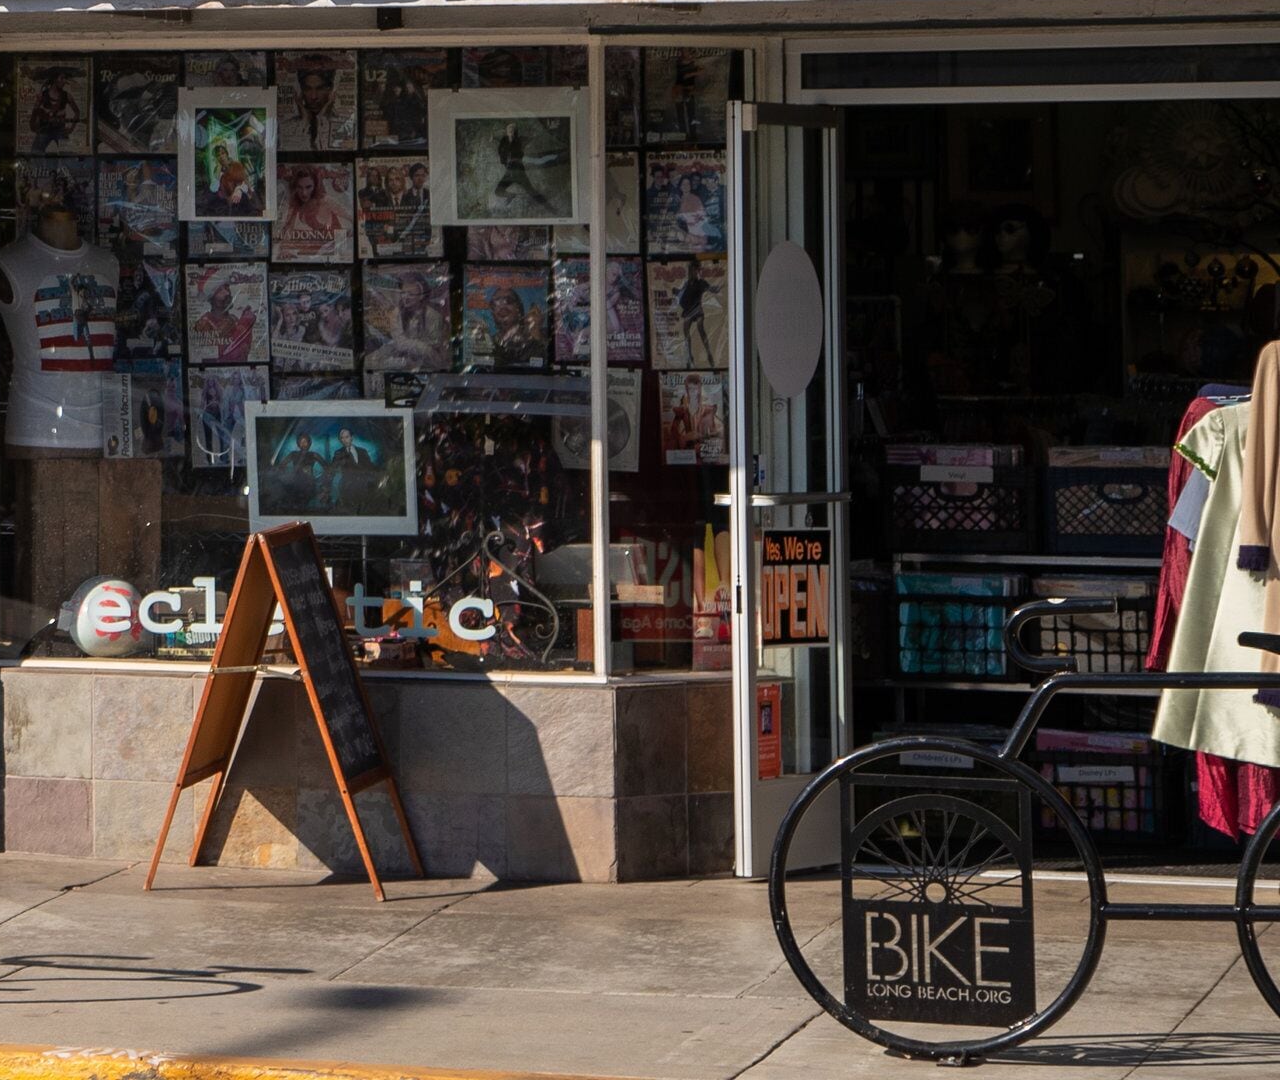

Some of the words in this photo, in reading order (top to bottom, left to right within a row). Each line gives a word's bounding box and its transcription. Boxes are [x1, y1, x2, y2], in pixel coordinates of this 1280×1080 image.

[365, 70, 388, 82] U2
[272, 229, 334, 241] MADONNA
[312, 347, 351, 358] PUMPKINS
[121, 375, 129, 415] Vacuum
[121, 416, 130, 457] Record
[89, 576, 497, 641] ecltic
[761, 564, 830, 640] OPEN
[912, 753, 948, 764] Children's
[1078, 770, 1103, 779] Disney
[865, 912, 1011, 988] BIKE
[867, 983, 912, 999] LONG
[918, 985, 1012, 1005] BEACH.ORG
